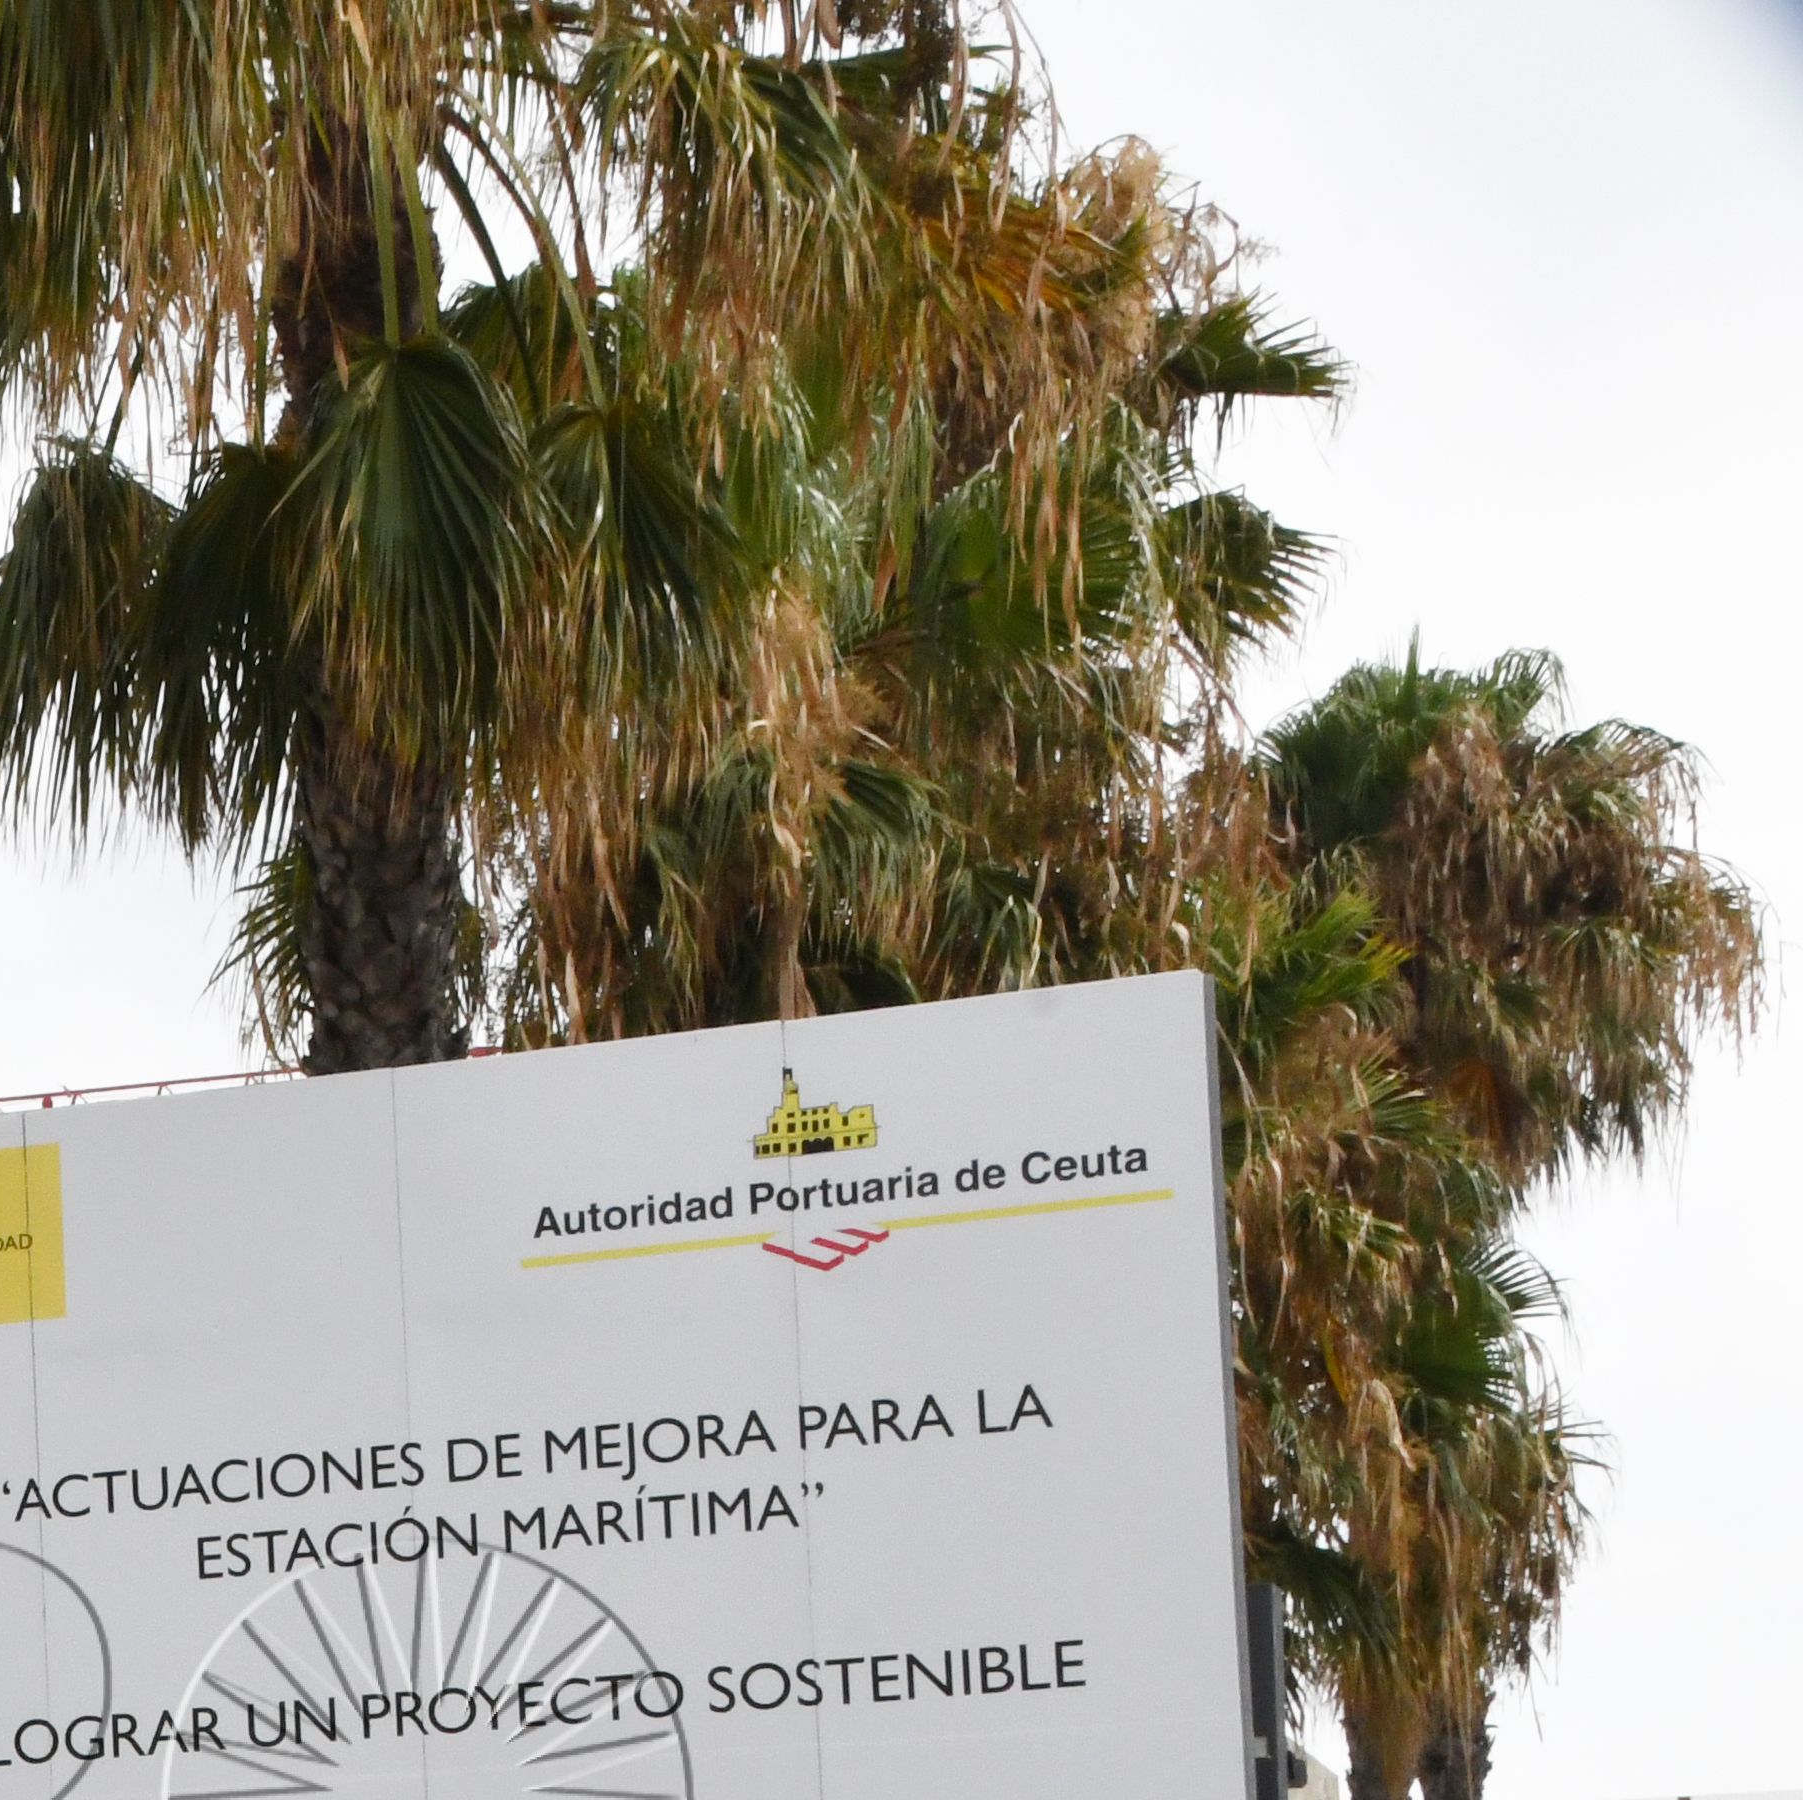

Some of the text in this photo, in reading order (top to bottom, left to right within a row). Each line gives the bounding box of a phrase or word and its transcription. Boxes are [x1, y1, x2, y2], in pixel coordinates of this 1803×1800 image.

[533, 1145, 1150, 1239] Autoridad Portuaria de Ceuta
[446, 1433, 522, 1483] DE
[544, 1410, 777, 1481] MEJORA
[797, 1394, 955, 1452] PARA
[977, 1383, 1054, 1435] LA
[196, 1506, 480, 1579] ESTACIÓN
[247, 1696, 340, 1748] UN
[360, 1668, 685, 1739] PROYECTO
[708, 1639, 1087, 1716] SOSTENIBLE
